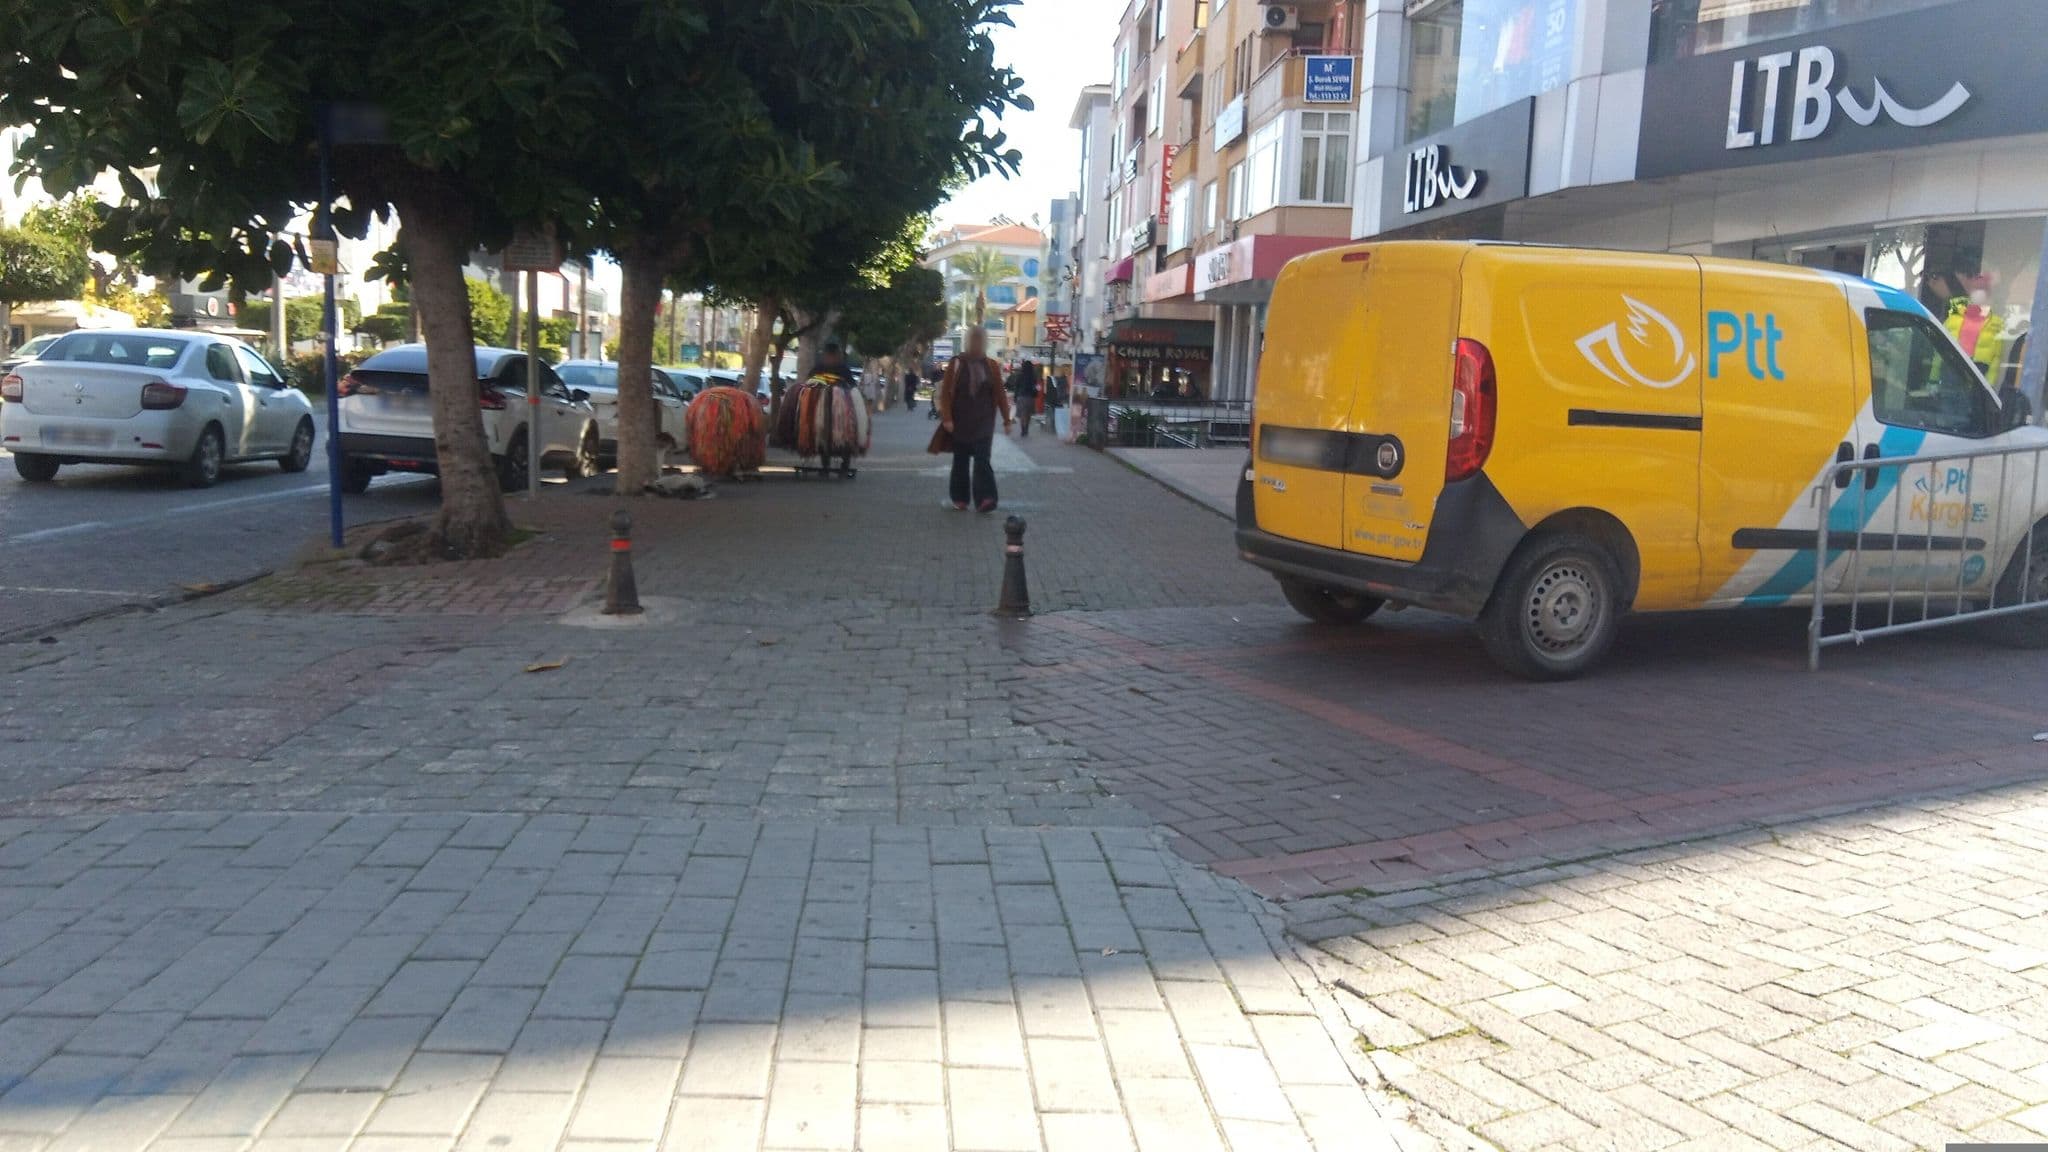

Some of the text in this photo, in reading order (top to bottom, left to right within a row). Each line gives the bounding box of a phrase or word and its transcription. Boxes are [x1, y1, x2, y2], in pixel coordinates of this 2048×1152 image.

[1725, 45, 1835, 150] LTB
[1403, 143, 1440, 214] LTB
[1708, 310, 1785, 381] Ptt
[1945, 467, 1971, 495] Pt
